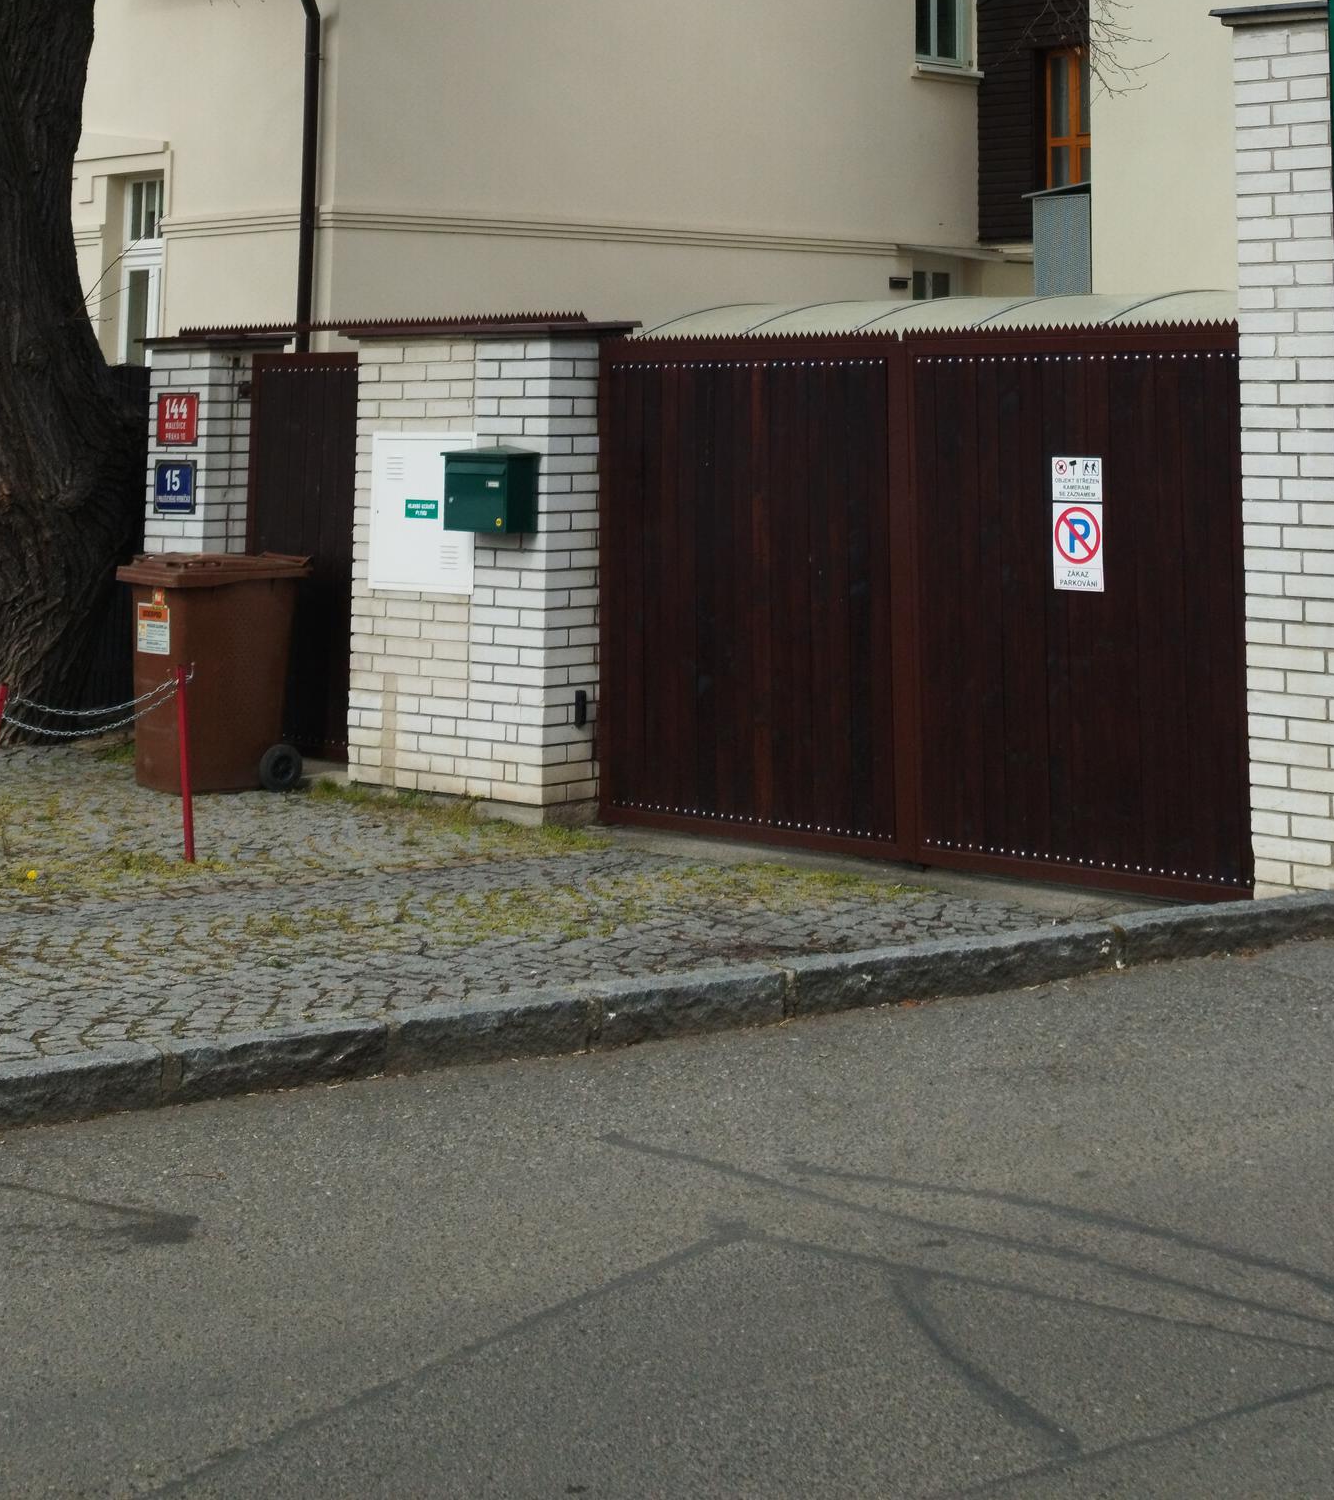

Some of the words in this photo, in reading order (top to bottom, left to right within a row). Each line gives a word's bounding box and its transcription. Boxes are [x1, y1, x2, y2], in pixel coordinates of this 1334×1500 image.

[165, 398, 187, 419] 144
[165, 432, 180, 441] PRAHA
[165, 469, 181, 491] 15
[1069, 519, 1091, 554] P
[1067, 570, 1089, 578] ZÁKAZ
[1059, 579, 1098, 588] PARKOVÁNÍ
